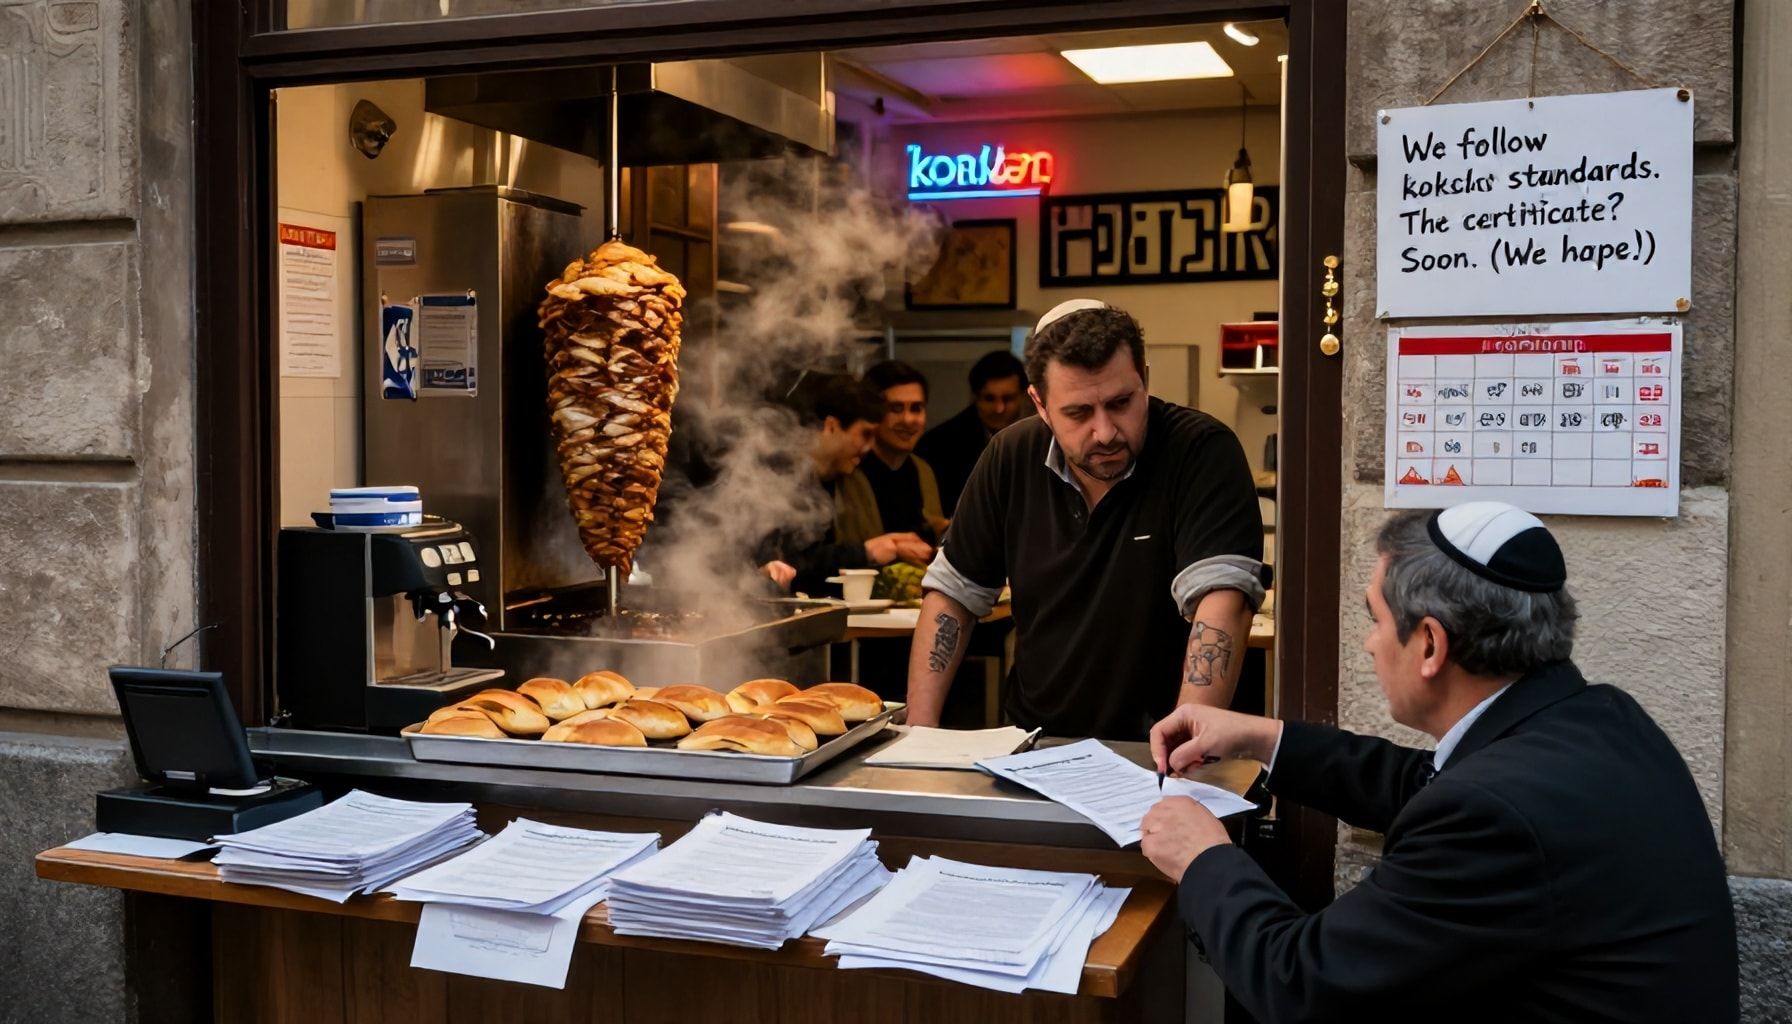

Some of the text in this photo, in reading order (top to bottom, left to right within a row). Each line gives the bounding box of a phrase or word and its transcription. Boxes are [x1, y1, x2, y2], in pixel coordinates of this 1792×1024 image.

[1402, 126, 1547, 163] We follow
[1400, 209, 1449, 236] The
[1401, 246, 1478, 273] Soon.
[1491, 238, 1547, 274] (We
